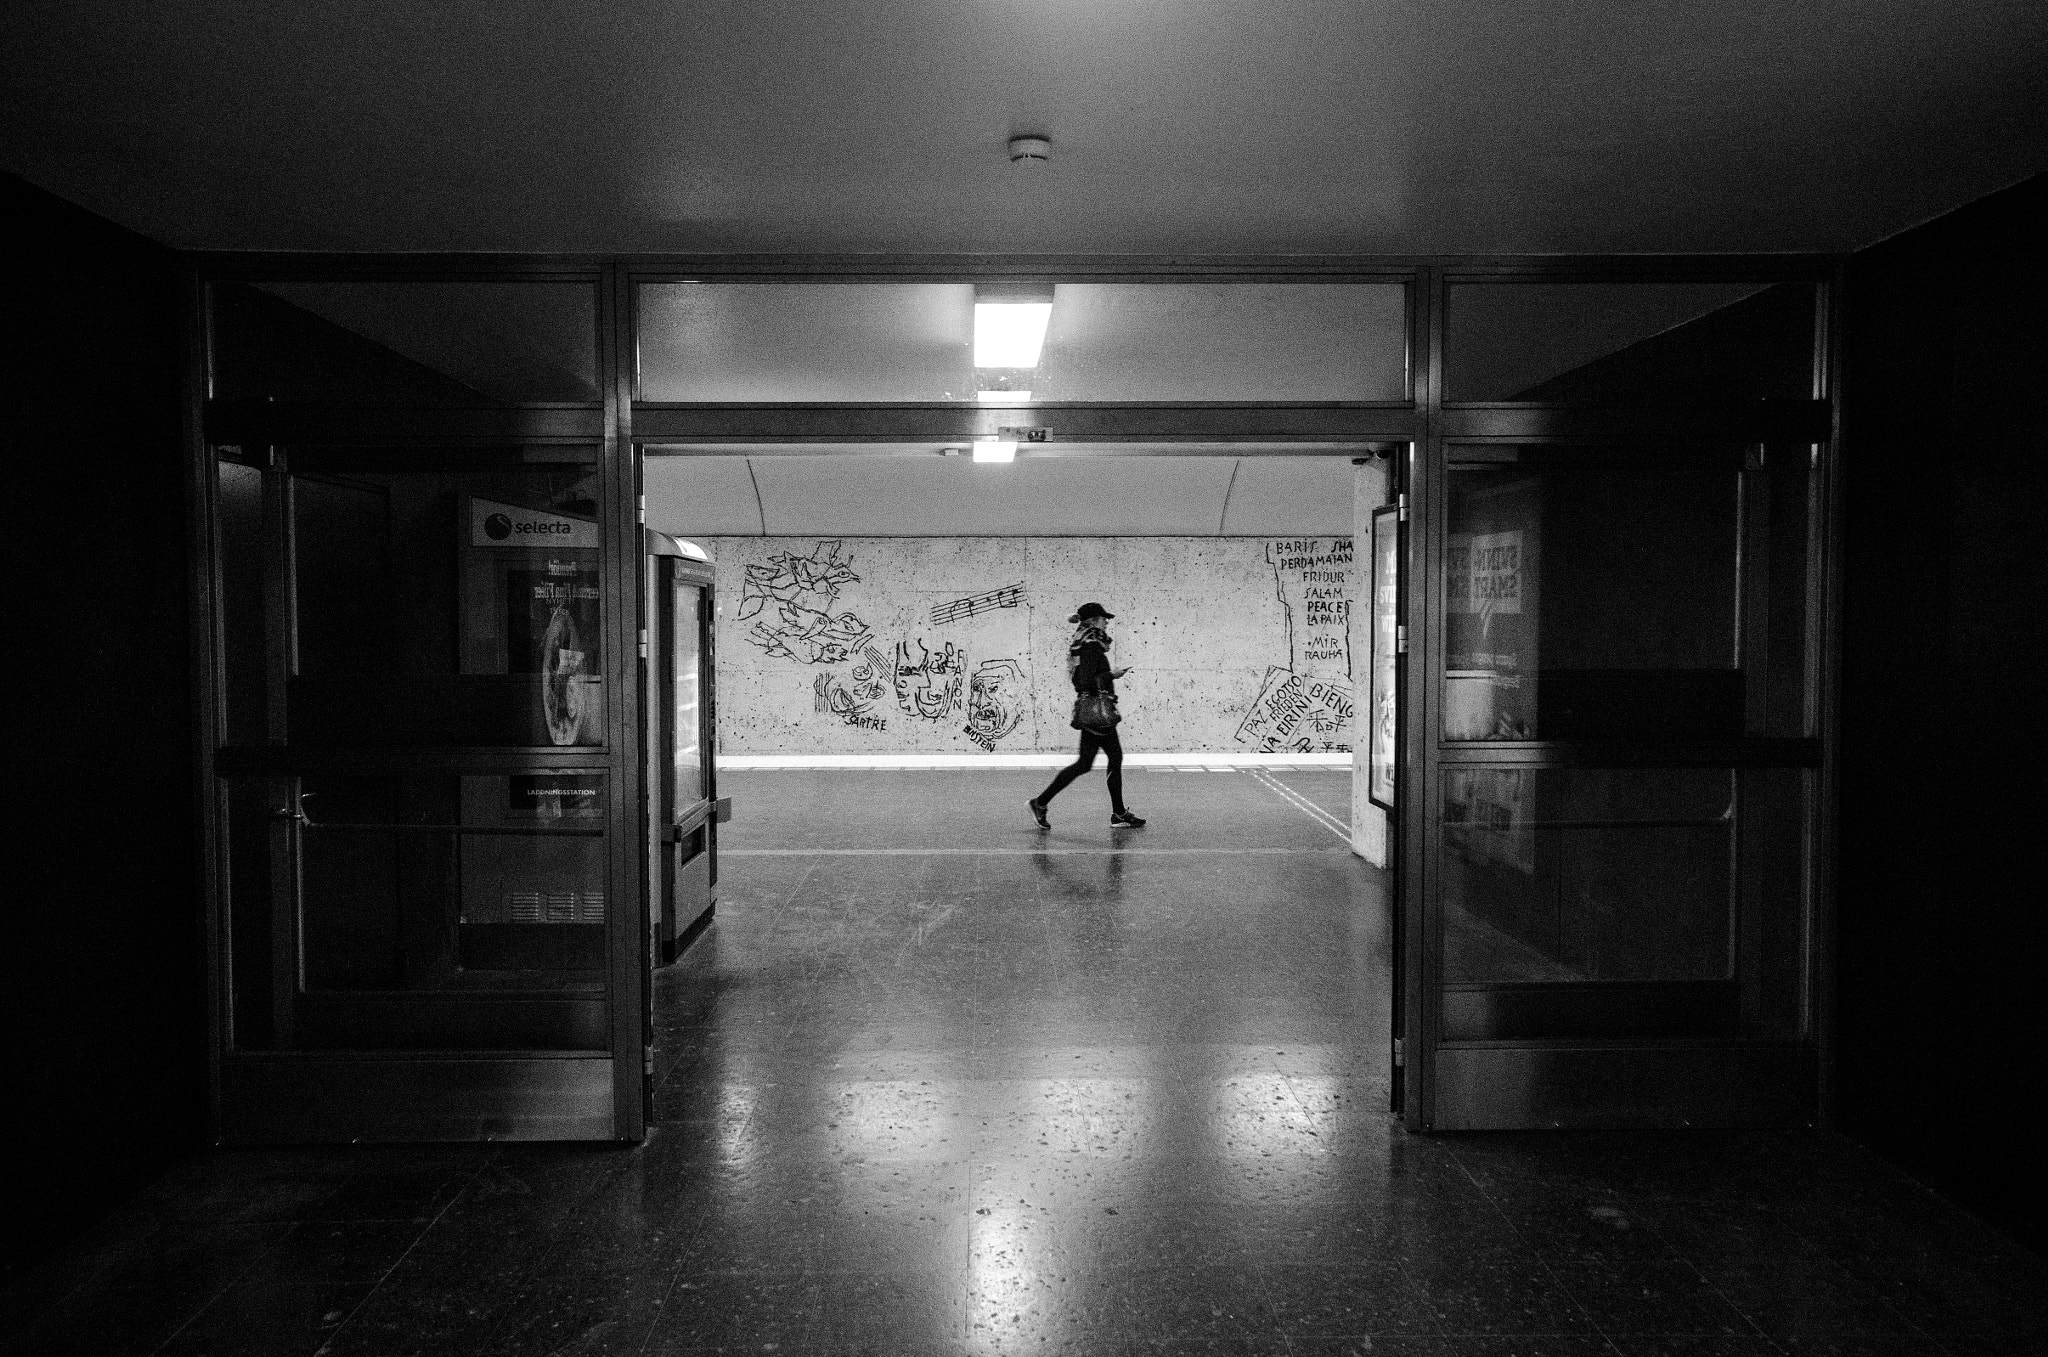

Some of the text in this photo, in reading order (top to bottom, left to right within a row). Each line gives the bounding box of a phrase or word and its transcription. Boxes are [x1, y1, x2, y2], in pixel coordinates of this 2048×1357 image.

[515, 521, 571, 534] selecta
[1281, 553, 1353, 570] PERDAMAIAN
[1303, 571, 1345, 583] FRIDUR
[1304, 587, 1343, 599] SALAM
[1307, 601, 1343, 613] PEACE
[1305, 649, 1343, 660] RAUHA
[1270, 689, 1302, 721] FRIEDEN
[844, 714, 887, 730] SARTRE
[1277, 696, 1312, 736] EIRINI
[1244, 709, 1268, 737] PAZ
[527, 788, 596, 796] LADDNINGSSTATION
